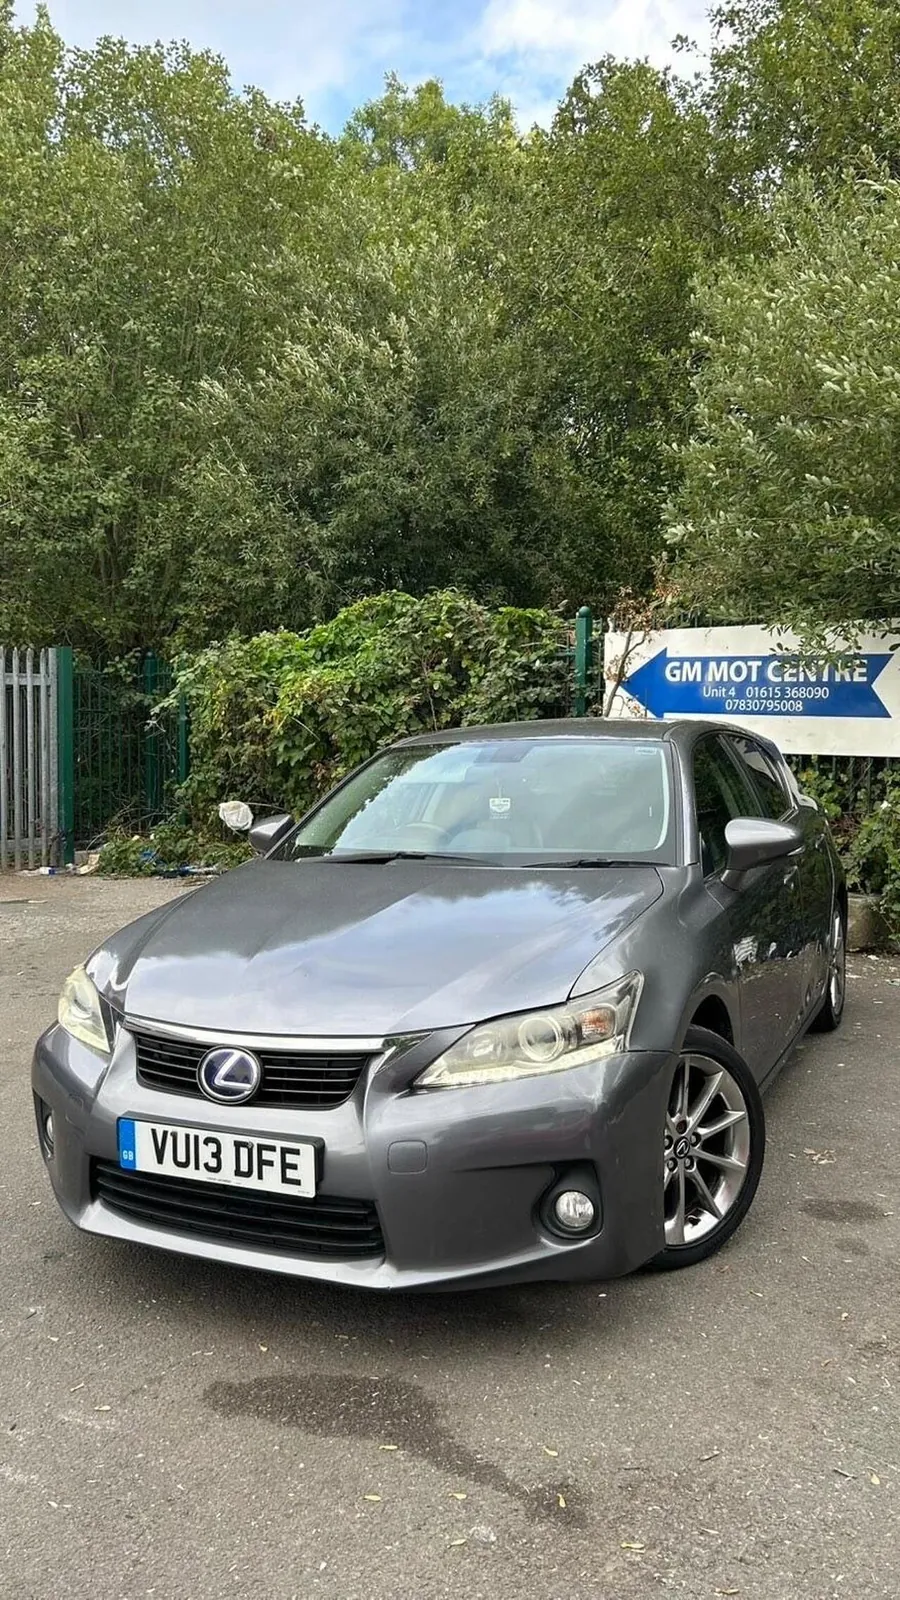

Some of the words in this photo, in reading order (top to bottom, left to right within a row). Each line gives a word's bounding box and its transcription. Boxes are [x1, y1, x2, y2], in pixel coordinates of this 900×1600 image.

[665, 660, 702, 682] GM
[707, 660, 762, 682] MOT
[703, 686, 726, 698] Unit
[728, 686, 736, 698] 4
[745, 686, 781, 698] 01615
[784, 686, 829, 699] 368090
[725, 699, 803, 712] 07830795008
[122, 1150, 134, 1161] GB
[151, 1128, 222, 1174] VU13
[233, 1139, 301, 1186] DFE
